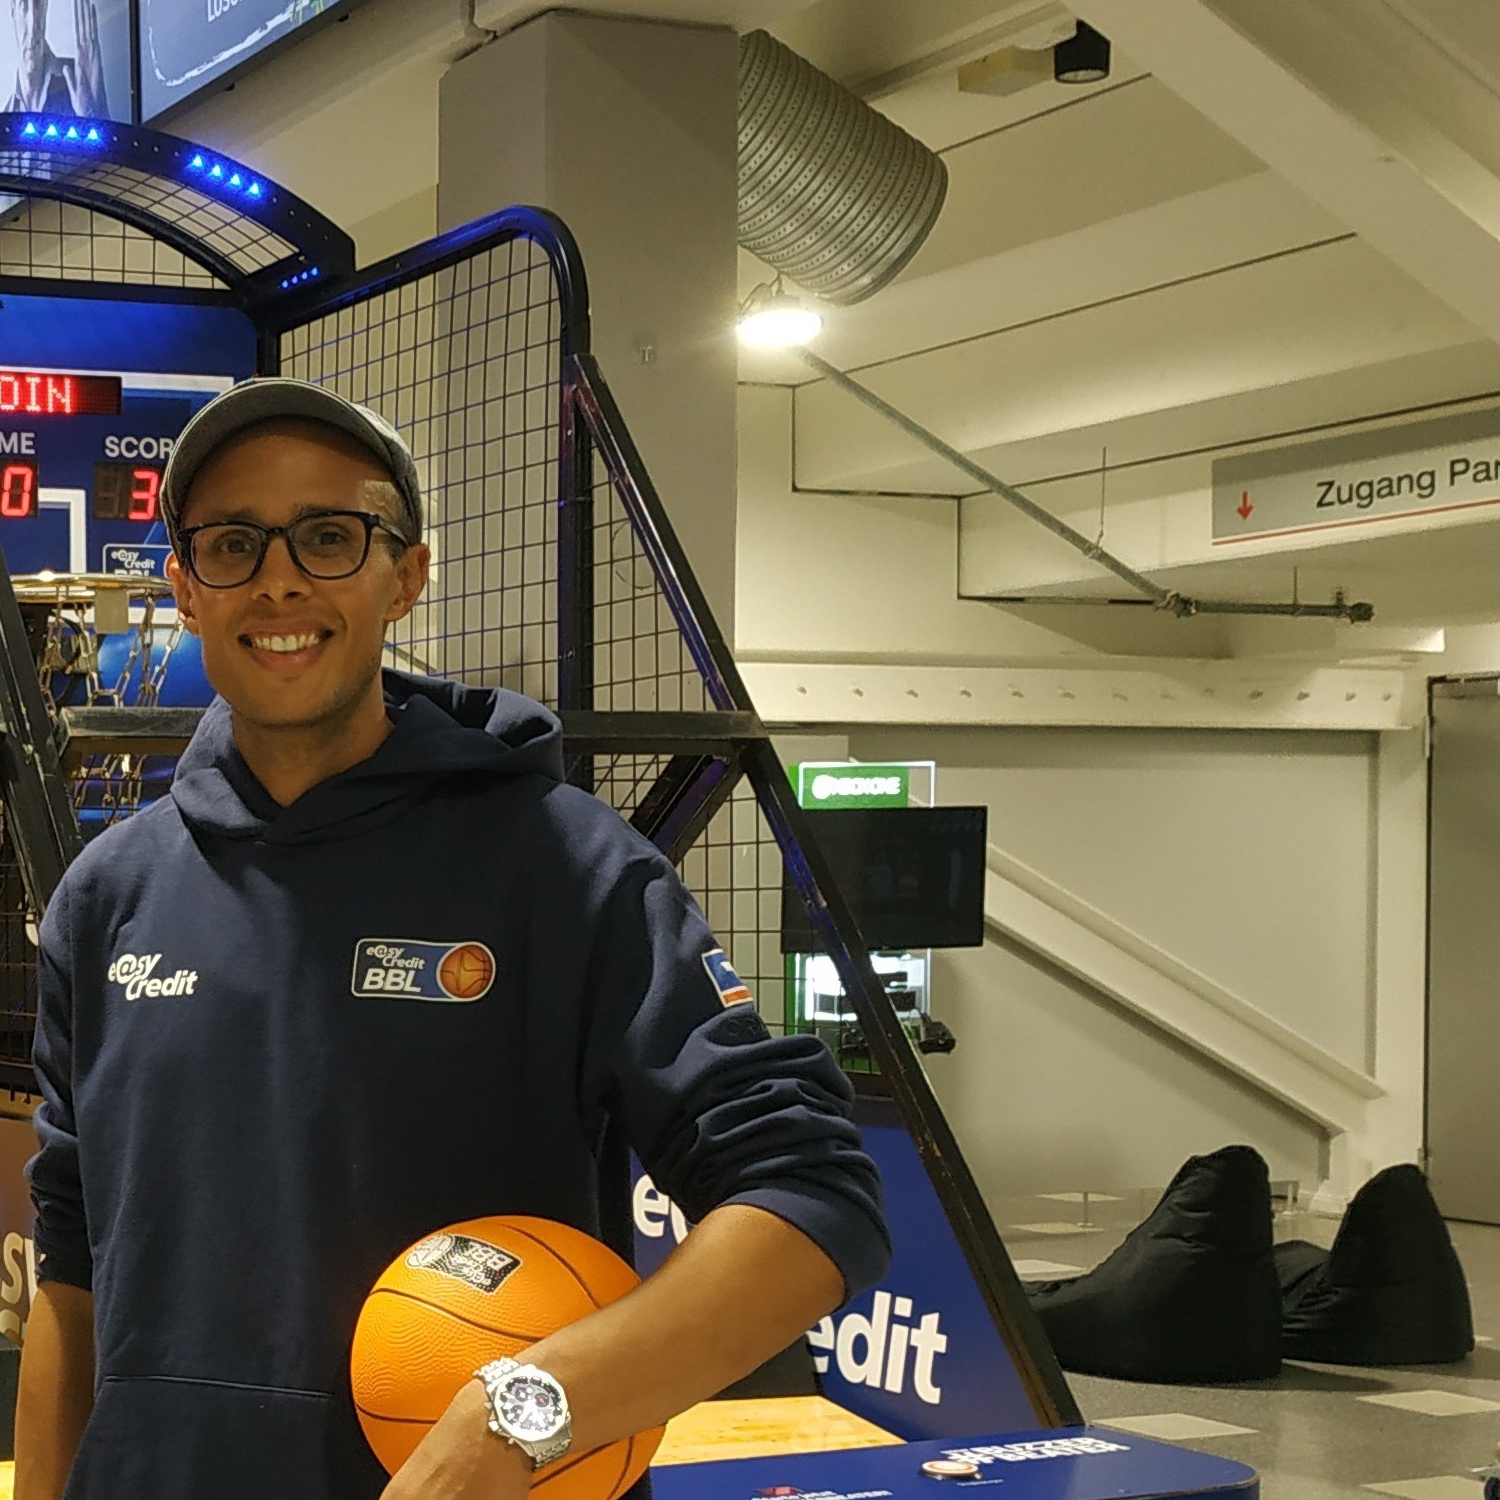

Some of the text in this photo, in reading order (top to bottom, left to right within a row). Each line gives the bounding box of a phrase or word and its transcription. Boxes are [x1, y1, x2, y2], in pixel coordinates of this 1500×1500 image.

[104, 435, 175, 460] SCOR
[1316, 470, 1437, 510] Zugang
[382, 956, 426, 970] Credit
[125, 969, 199, 1001] Credit
[362, 967, 422, 993] BBL
[806, 1289, 948, 1405] edit
